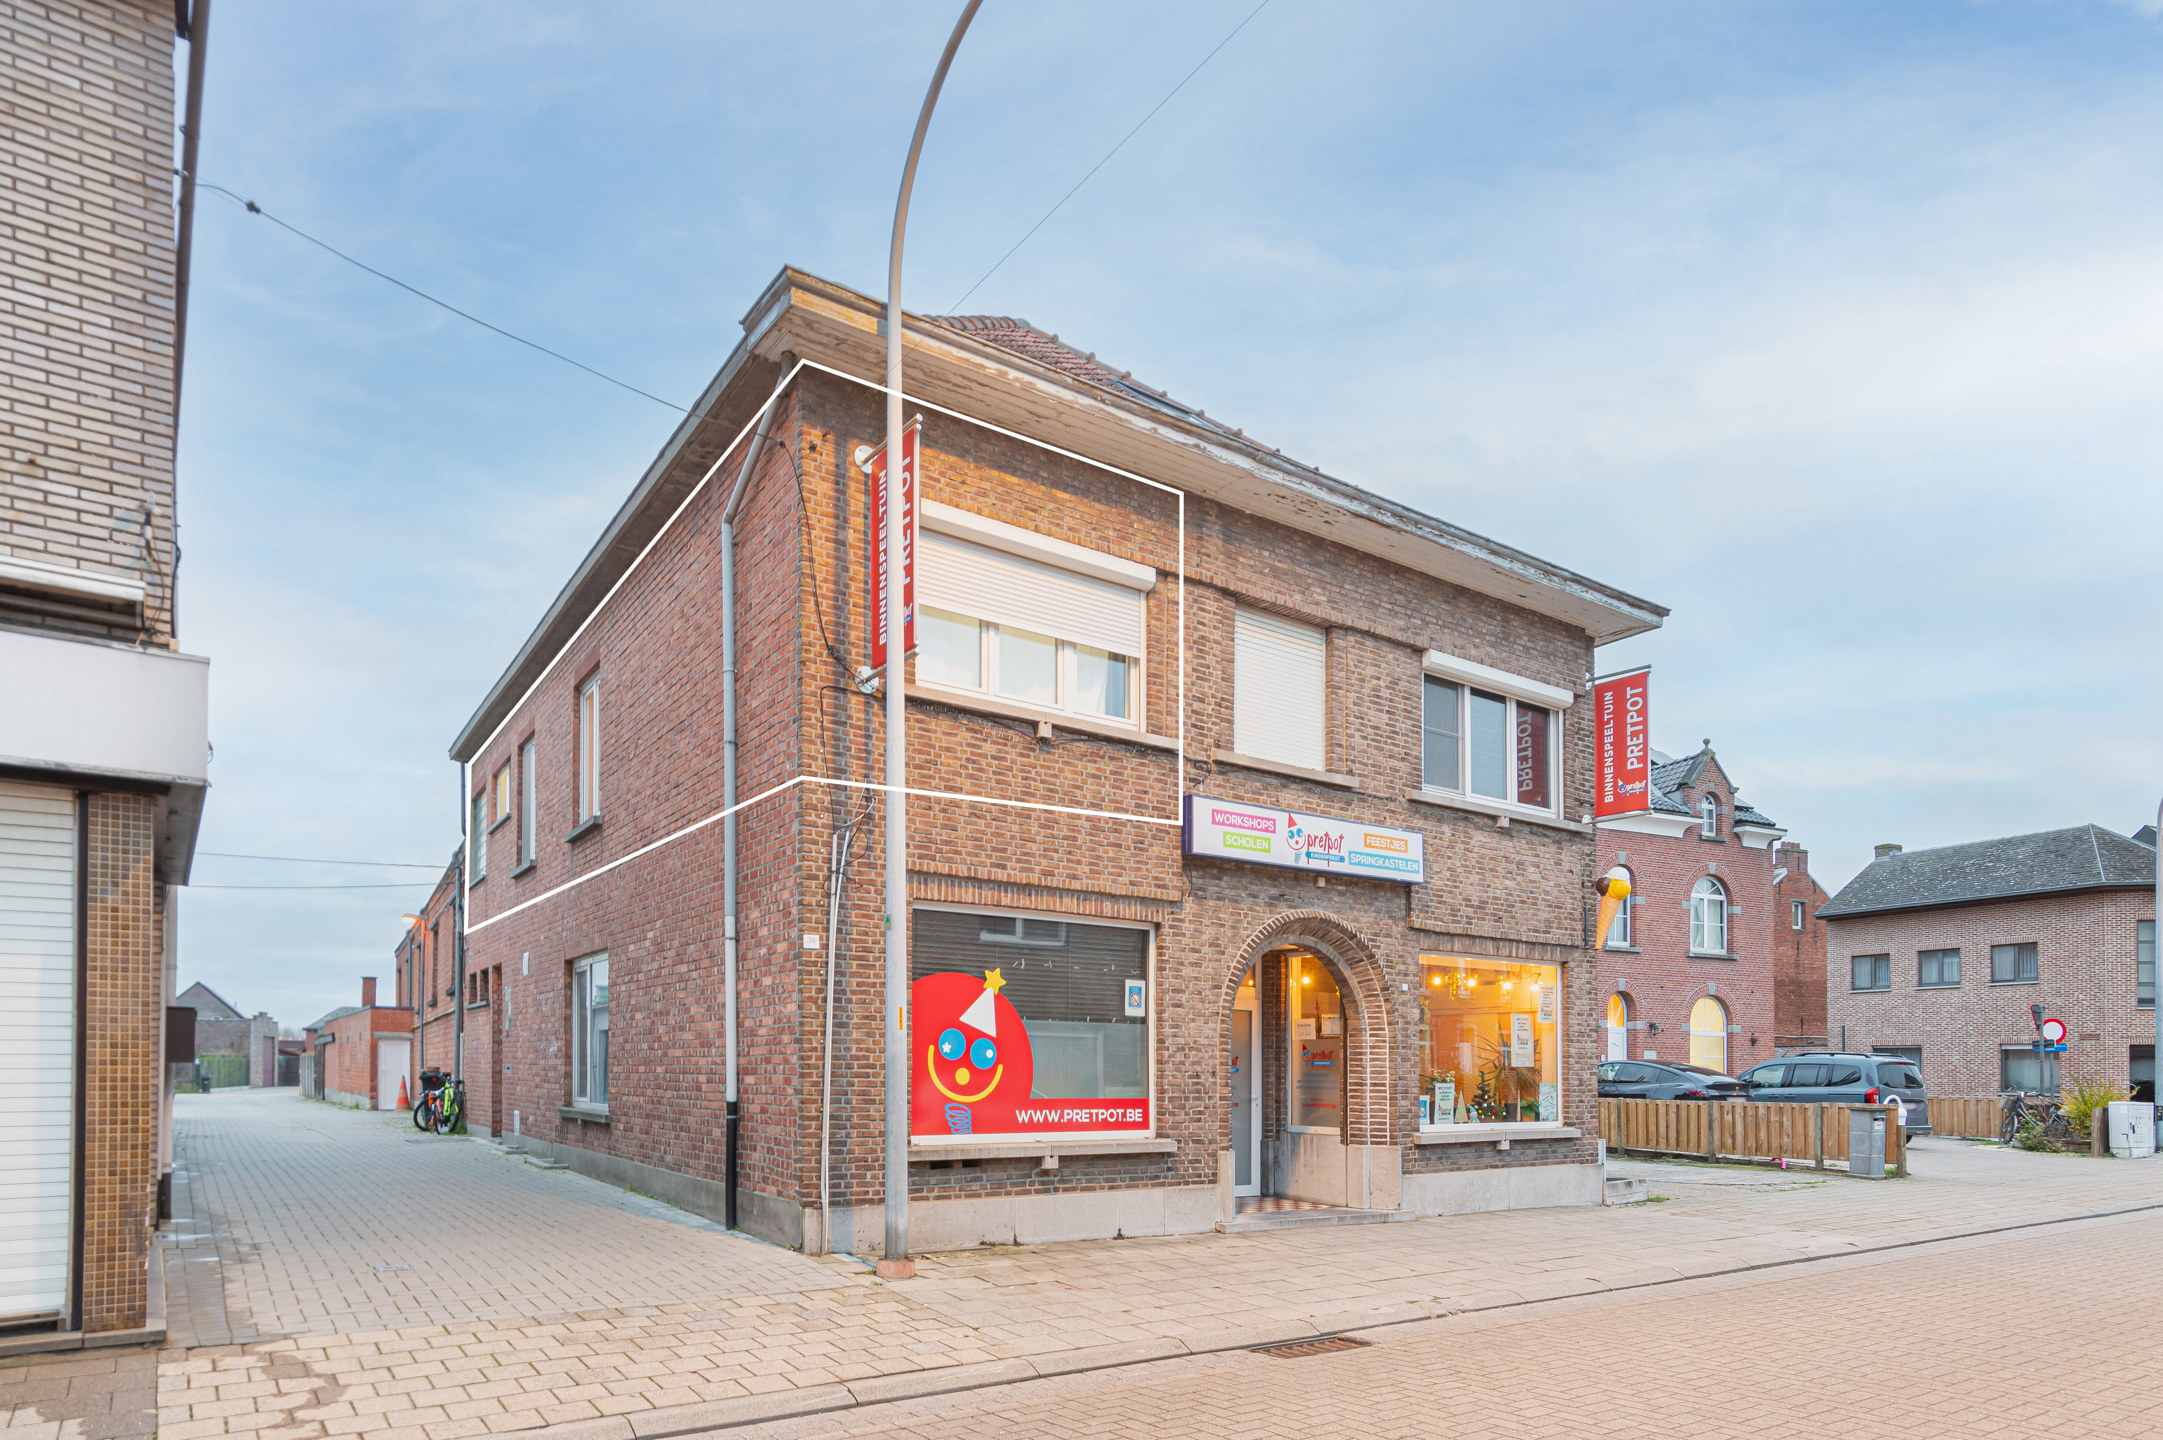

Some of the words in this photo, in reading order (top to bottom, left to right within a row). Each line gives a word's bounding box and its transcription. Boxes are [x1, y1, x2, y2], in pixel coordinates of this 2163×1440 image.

[879, 469, 887, 646] BINNENSPEELTUIN
[1626, 686, 1644, 770] PRETPOT
[1604, 691, 1614, 803] BINNENSPEELTUIN
[1214, 812, 1275, 831] WORKSHOPS
[1225, 834, 1269, 850] SCHOLEN
[1307, 832, 1344, 867] pretpot
[1366, 836, 1406, 851] FEESTJES
[1350, 853, 1418, 871] SPRINGKASTELEN
[1016, 1109, 1143, 1124] WWW.PRETPOT.BE
